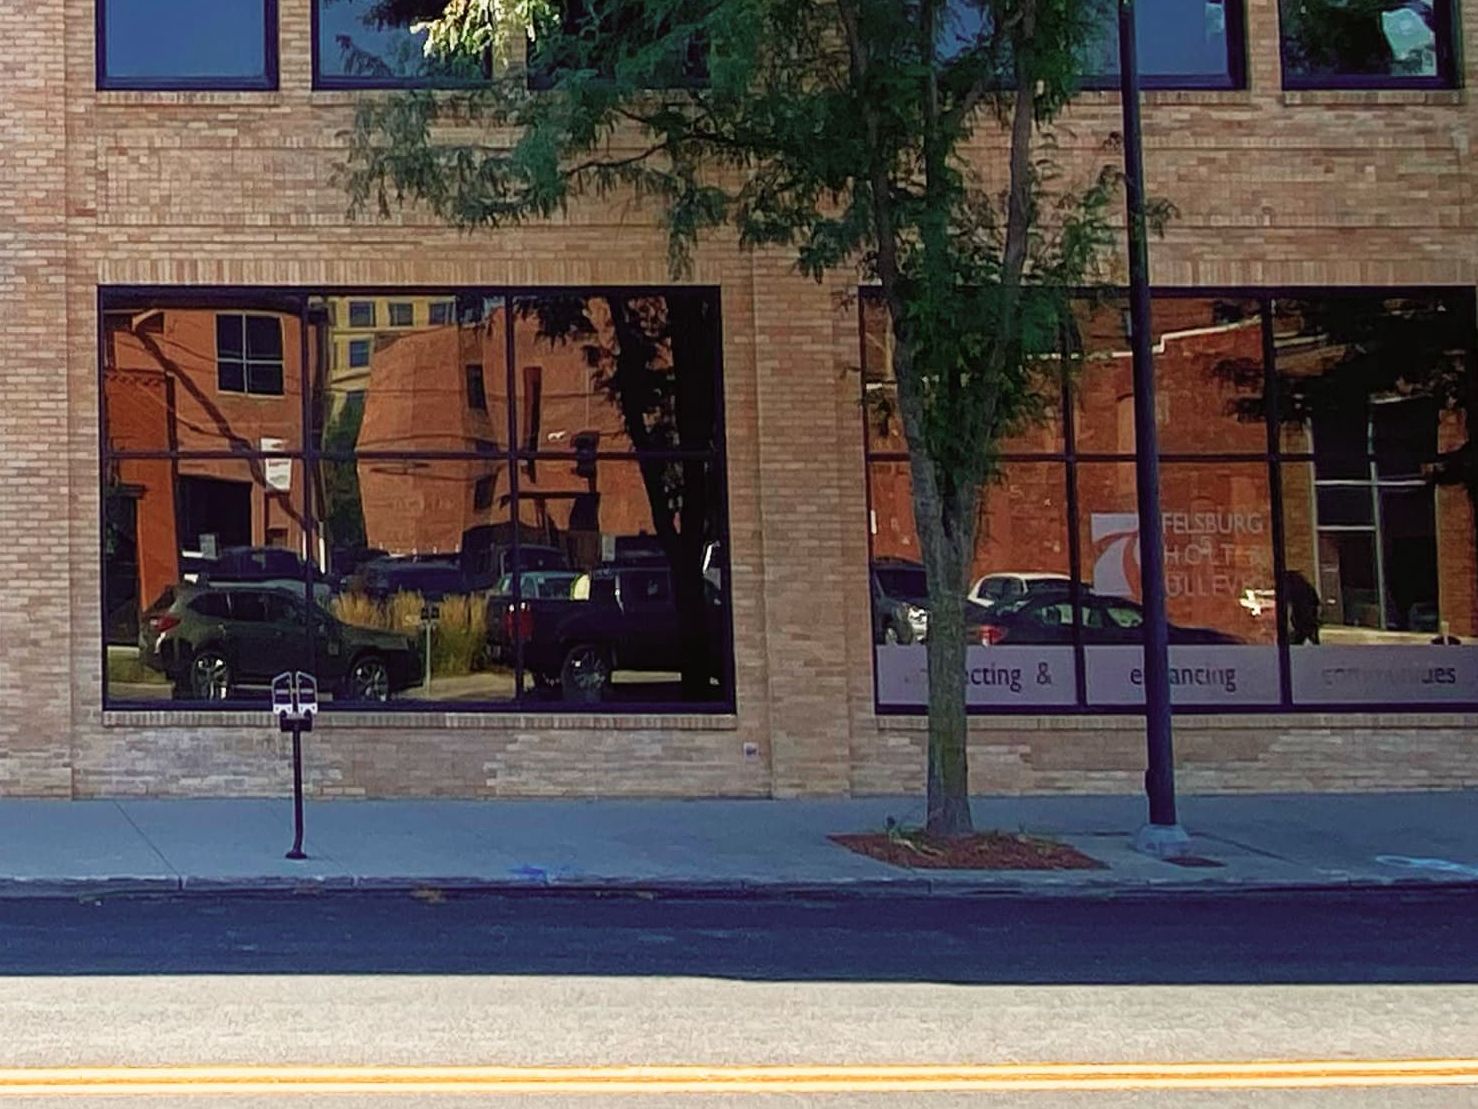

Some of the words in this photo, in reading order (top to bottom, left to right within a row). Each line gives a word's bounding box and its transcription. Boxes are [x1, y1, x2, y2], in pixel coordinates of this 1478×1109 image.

[1162, 513, 1263, 534] FELSBURG
[1036, 662, 1052, 685] &
[1130, 667, 1236, 692] eancing
